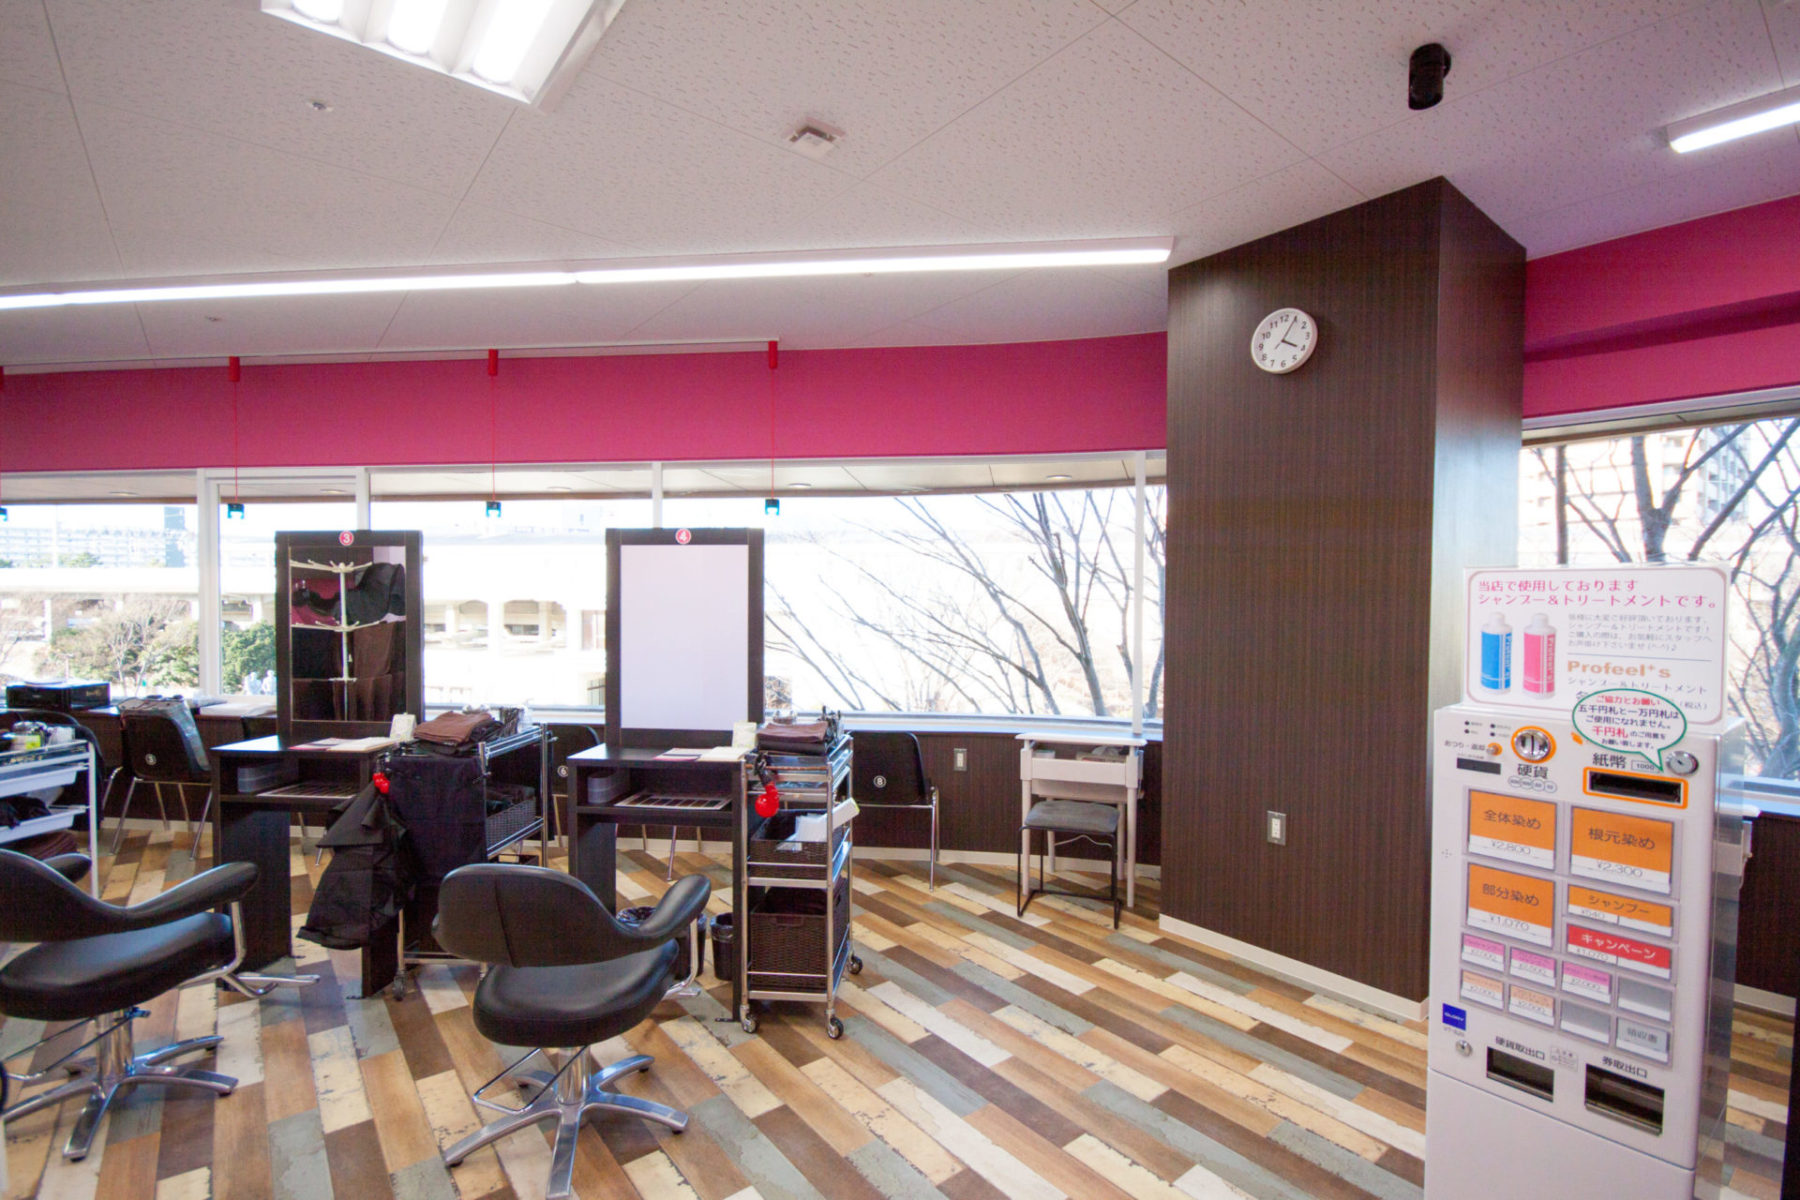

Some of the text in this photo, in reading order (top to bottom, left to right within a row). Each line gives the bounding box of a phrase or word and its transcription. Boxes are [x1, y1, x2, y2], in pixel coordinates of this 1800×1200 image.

[1301, 321, 1306, 329] 2
[1262, 332, 1271, 340] 10
[1305, 332, 1310, 340] 3
[343, 533, 350, 543] 3
[680, 531, 687, 541] 4
[1478, 580, 1638, 592] 当店で使用しております
[1578, 704, 1679, 719] 五千円札と一万円札は
[1586, 715, 1671, 729] ご使用になれません。
[1593, 753, 1627, 769] 紙幣
[1518, 763, 1548, 779] 硬貨
[1484, 810, 1541, 830] 全体染め
[1589, 827, 1655, 850] 根元染め
[1491, 840, 1531, 855] ¥2,800
[1596, 860, 1643, 878] ¥2,300
[1482, 883, 1539, 906] 部分染め
[1589, 895, 1649, 914] シャンプー
[1490, 914, 1529, 931] ¥1,070
[1581, 933, 1656, 959] キャンペーン
[1496, 1036, 1545, 1060] 硬貨取出口
[1602, 1056, 1647, 1078] 券取出口
